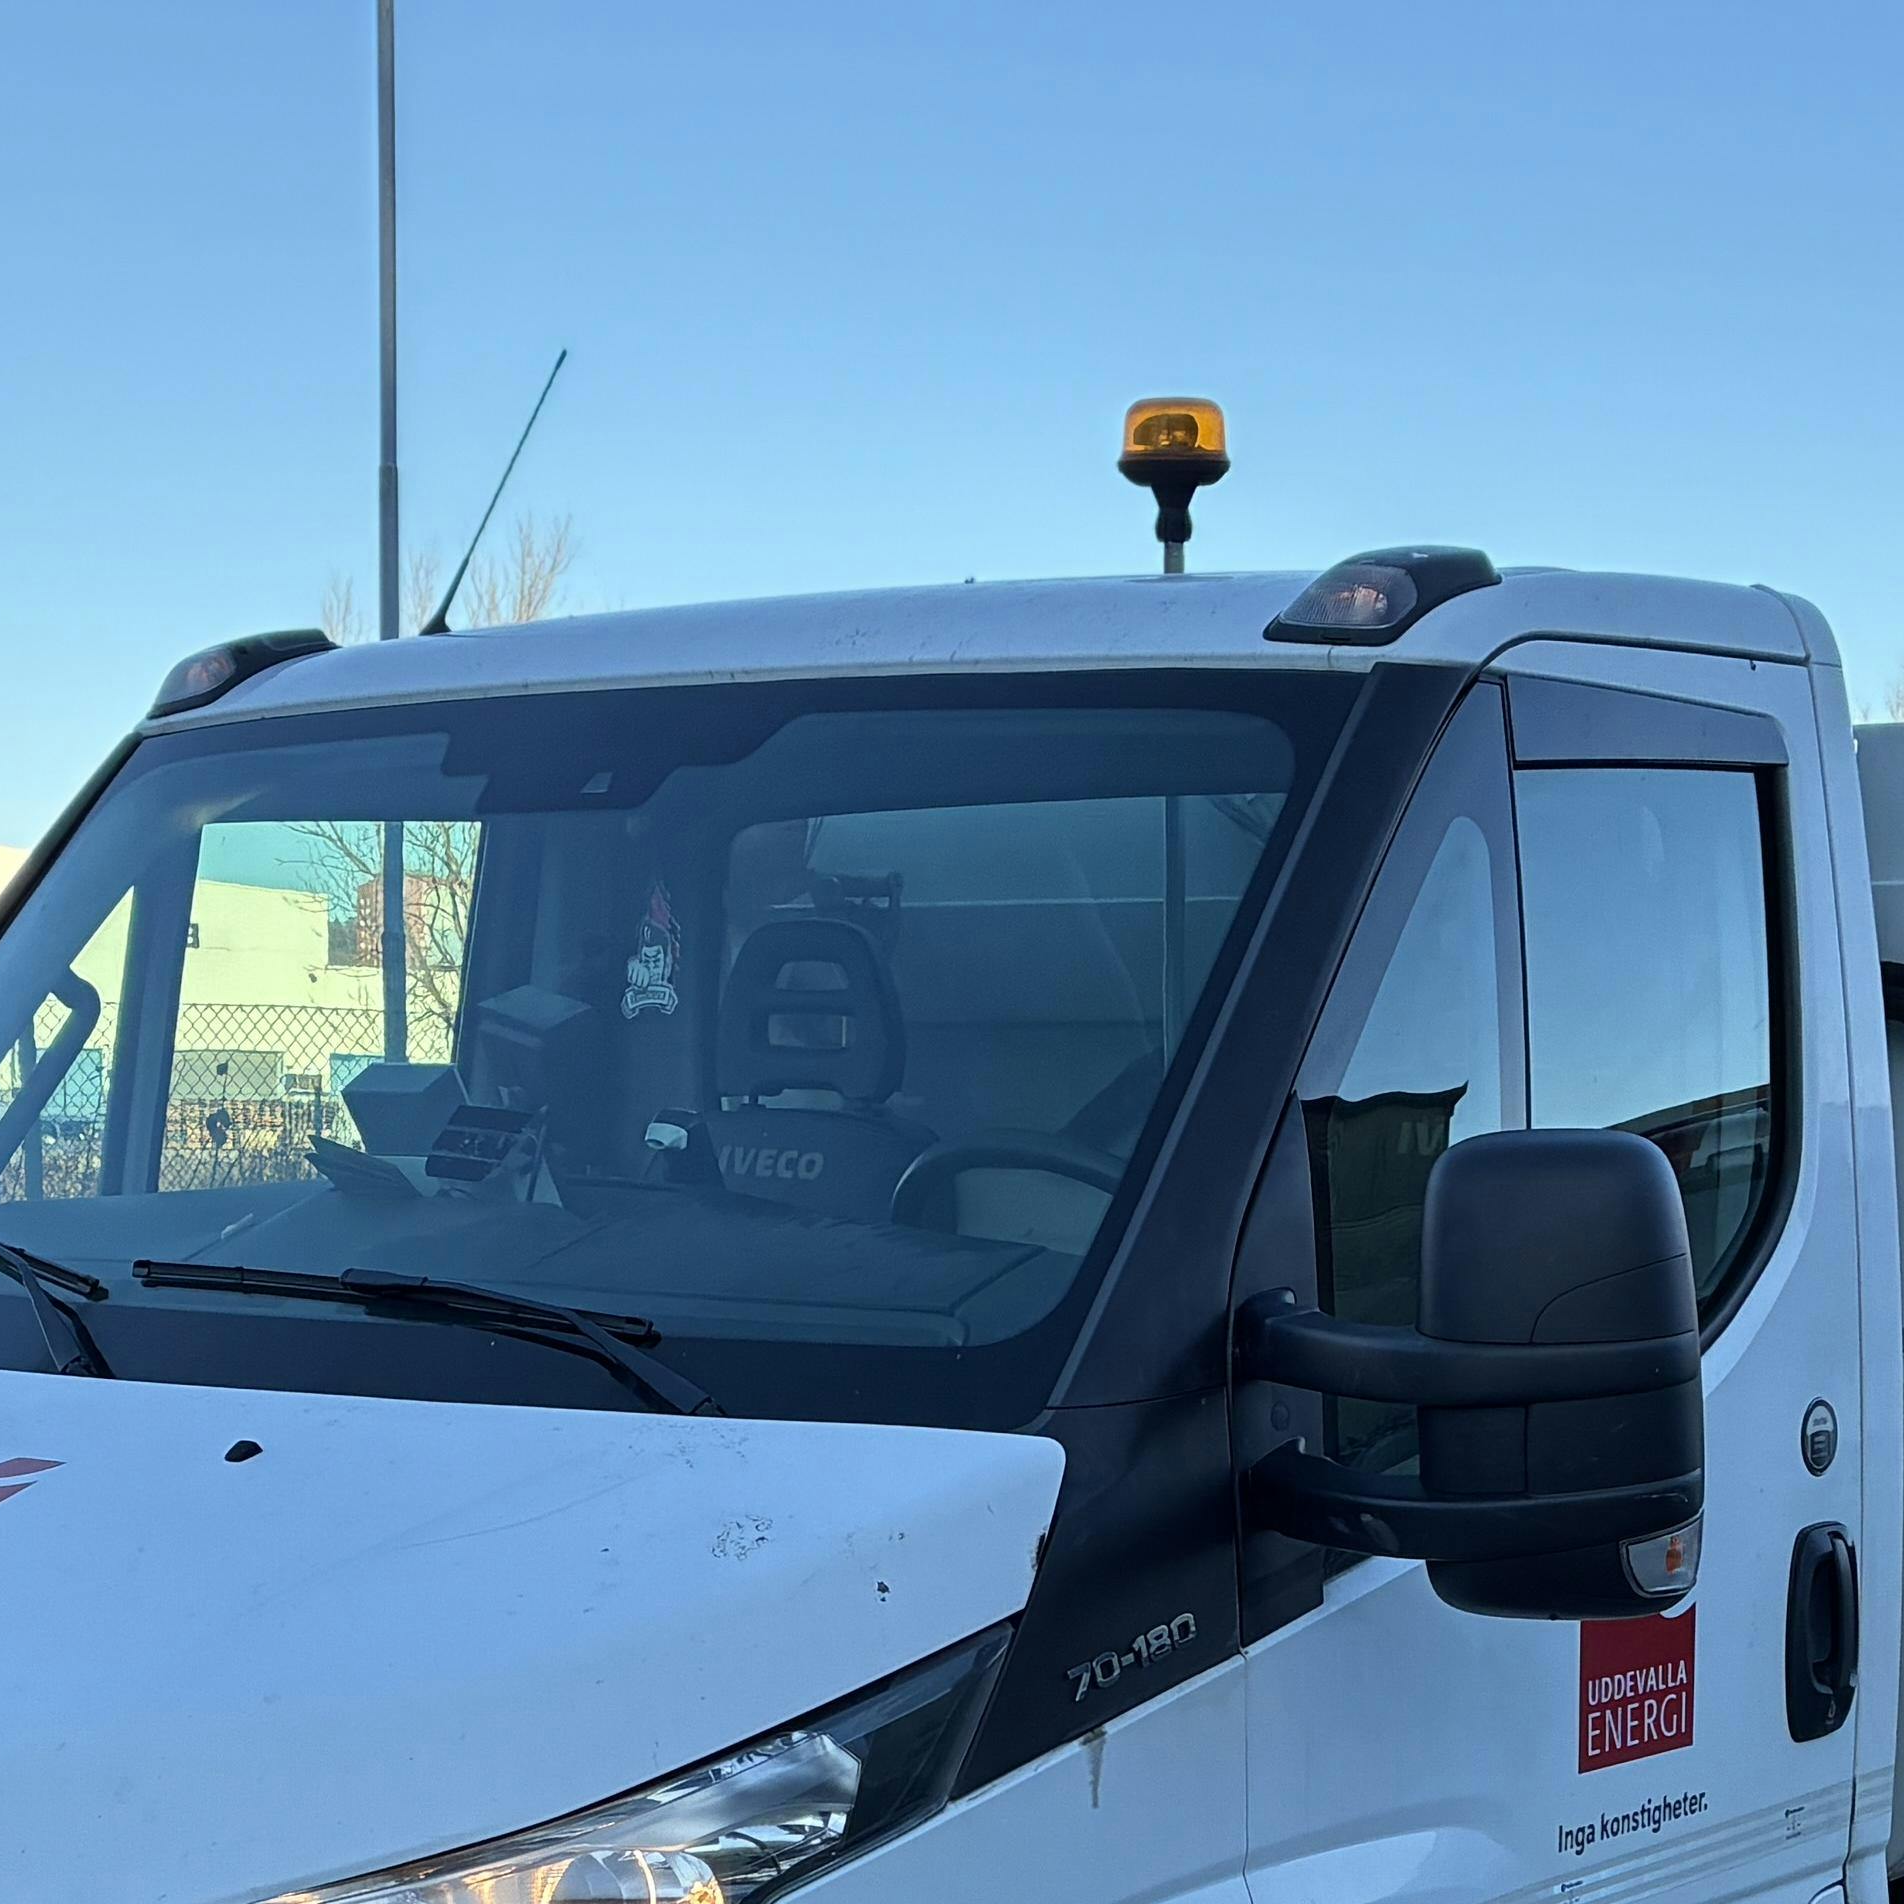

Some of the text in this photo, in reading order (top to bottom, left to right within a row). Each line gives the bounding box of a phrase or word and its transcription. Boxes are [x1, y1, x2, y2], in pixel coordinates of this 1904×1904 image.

[718, 1146, 824, 1179] IVECO
[1067, 1613, 1197, 1702] 70-180
[1588, 1660, 1687, 1706] UDDEVALLA
[1587, 1692, 1686, 1757] ENERGI
[1558, 1791, 1709, 1856] Inga konstigheter.
